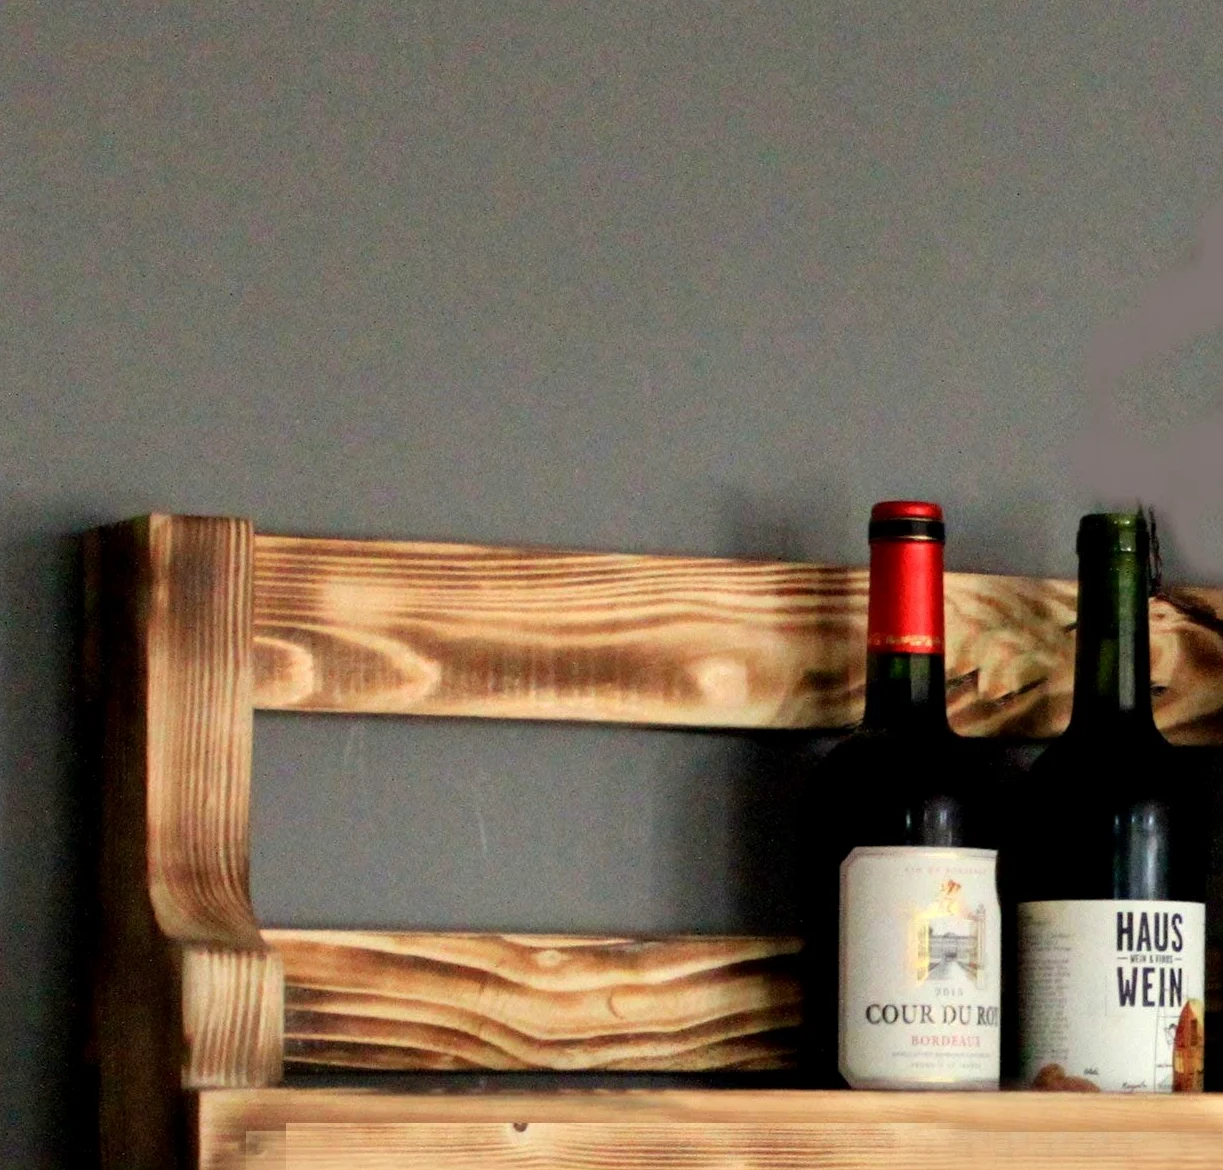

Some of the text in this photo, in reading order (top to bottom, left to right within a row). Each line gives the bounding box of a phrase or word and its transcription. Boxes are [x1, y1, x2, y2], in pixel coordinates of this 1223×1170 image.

[1117, 911, 1183, 952] HAUS
[1117, 966, 1183, 1007] WEIN
[865, 1004, 936, 1025] COUR
[942, 1004, 972, 1026] DU
